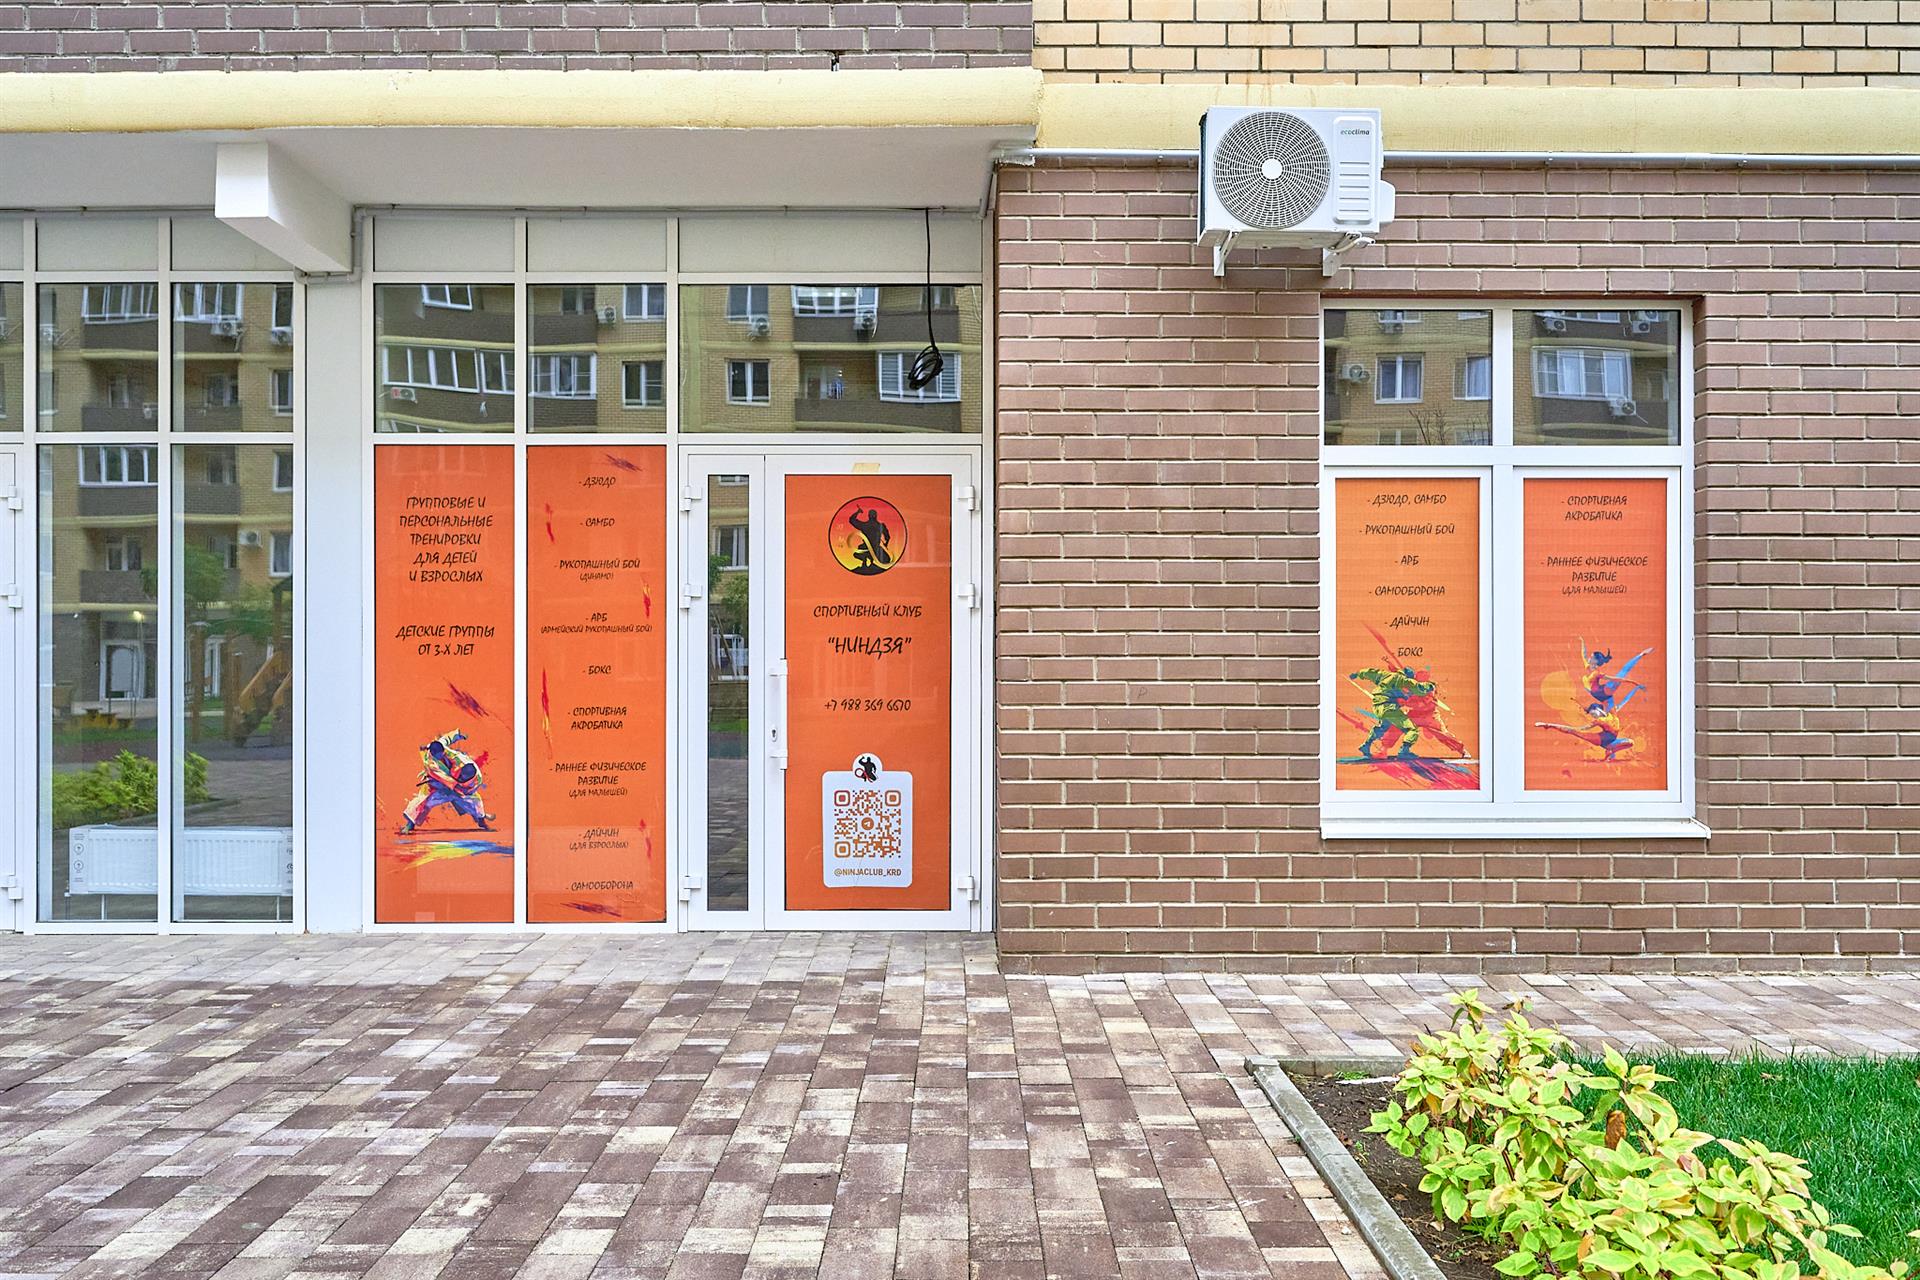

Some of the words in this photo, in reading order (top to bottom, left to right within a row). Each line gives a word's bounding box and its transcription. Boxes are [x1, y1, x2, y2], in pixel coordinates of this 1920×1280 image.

[1340, 128, 1370, 136] ecoclima
[583, 476, 617, 489] ДЗЮДО
[406, 496, 474, 510] ГРУППОВЫЕ
[477, 496, 486, 508] И
[1371, 494, 1411, 507] ДЗЮДО,
[1413, 493, 1447, 505] САМБО
[1567, 495, 1628, 506] СПОРТИВНАЯ
[399, 514, 494, 528] ПЕРСОНАЛЬНЫЕ
[1564, 510, 1623, 522] АКРОБАТИКА
[585, 517, 616, 528] САМБО
[1365, 522, 1433, 536] РУКОПАШНЫЙ
[1435, 522, 1455, 535] БОЙ
[409, 532, 482, 546] ТРЕНИРОВКИ
[412, 551, 440, 567] ДЛЯ
[442, 549, 478, 566] ДЕТЕЙ
[559, 558, 621, 570] РУКОПАШНЫЙ
[622, 558, 641, 569] БОЙ
[1400, 554, 1420, 566] АРБ
[1547, 556, 1583, 567] РАННЕЕ
[1585, 555, 1648, 567] ФИЗИЧЕСКОЕ
[408, 569, 418, 582] И
[420, 569, 484, 583] ВЗРОСЛЫХ
[1571, 571, 1617, 583] РАЗВИТИЕ
[1374, 585, 1446, 597] САМООБОРОНА
[813, 603, 890, 618] СПОРТИВНЫЙ
[892, 605, 923, 618] КЛУБ
[590, 612, 608, 623] АРБ
[1389, 614, 1430, 629] ДАЙЧИН
[394, 624, 447, 641] ДЕТСКИЕ
[448, 624, 495, 639] ГРУППЫ
[417, 643, 432, 657] ОТ
[451, 643, 476, 657] ЛЕТ
[1397, 646, 1424, 658] БОКС
[587, 664, 612, 676] БОКС
[824, 699, 838, 712] +7
[840, 698, 862, 711] 988
[864, 698, 884, 712] 369
[886, 698, 912, 712] 6670
[572, 706, 628, 717] СПОРТИВНАЯ
[570, 719, 624, 731] АКРОБАТИКА
[555, 762, 588, 773] РАННЕЕ
[589, 761, 647, 772] ФИЗИЧЕСКОЕ
[577, 775, 619, 786] РАЗВИТИЕ
[583, 827, 620, 841] ДАЙЧИН
[834, 867, 902, 878] @NINJACLUB_KRD
[571, 880, 634, 892] САМООБОРОНА
